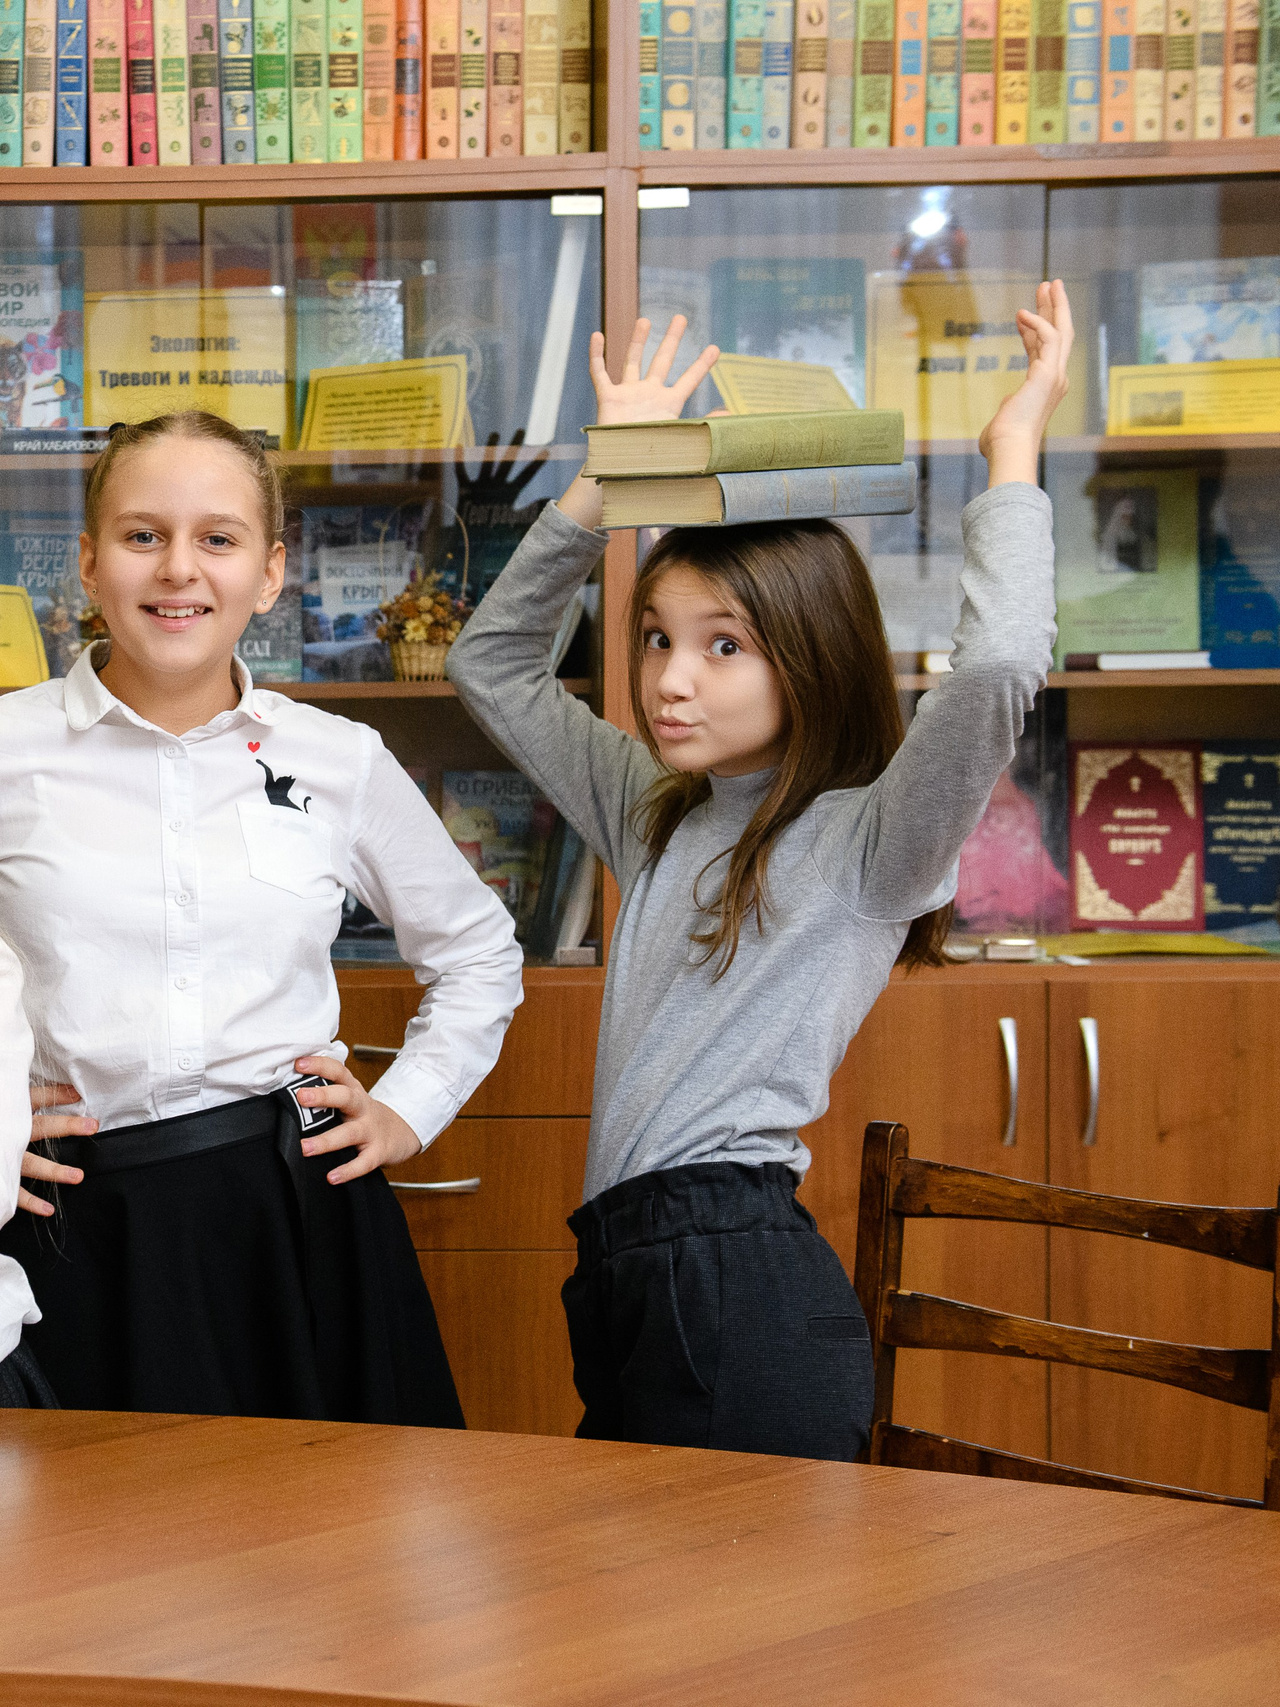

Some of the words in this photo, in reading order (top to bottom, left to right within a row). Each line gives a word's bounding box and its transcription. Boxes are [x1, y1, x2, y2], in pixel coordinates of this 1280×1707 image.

[150, 334, 241, 353] Экология:
[98, 369, 171, 389] Тревоги
[178, 370, 191, 387] и
[197, 368, 291, 388] надежды
[13, 439, 41, 452] КРАЙ
[43, 440, 111, 452] ХАБАРОВСКИ
